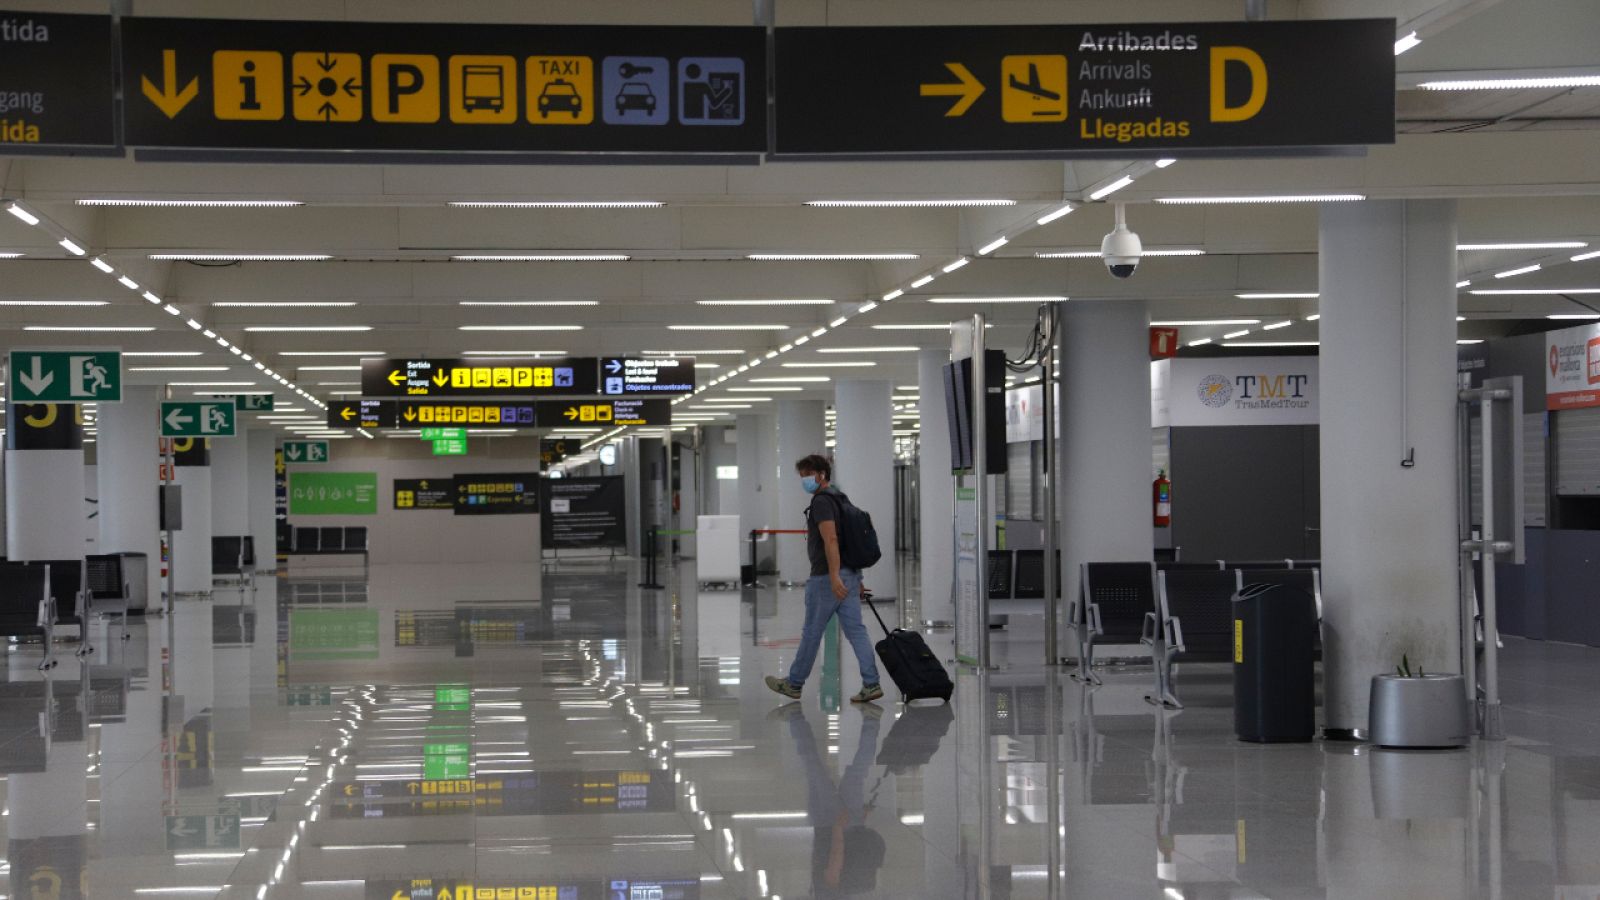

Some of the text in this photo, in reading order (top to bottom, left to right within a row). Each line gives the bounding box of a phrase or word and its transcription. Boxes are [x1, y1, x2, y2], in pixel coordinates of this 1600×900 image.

[0, 19, 49, 42] tida
[1079, 30, 1198, 51] Arribades
[538, 60, 580, 76] TAXI
[1079, 60, 1152, 80] Arrivals
[387, 63, 425, 114] P
[1210, 46, 1268, 122] D
[1079, 87, 1152, 109] Ankunft
[1080, 117, 1191, 142] Llegadas
[407, 361, 431, 369] Sortida
[1235, 372, 1308, 399] TMT
